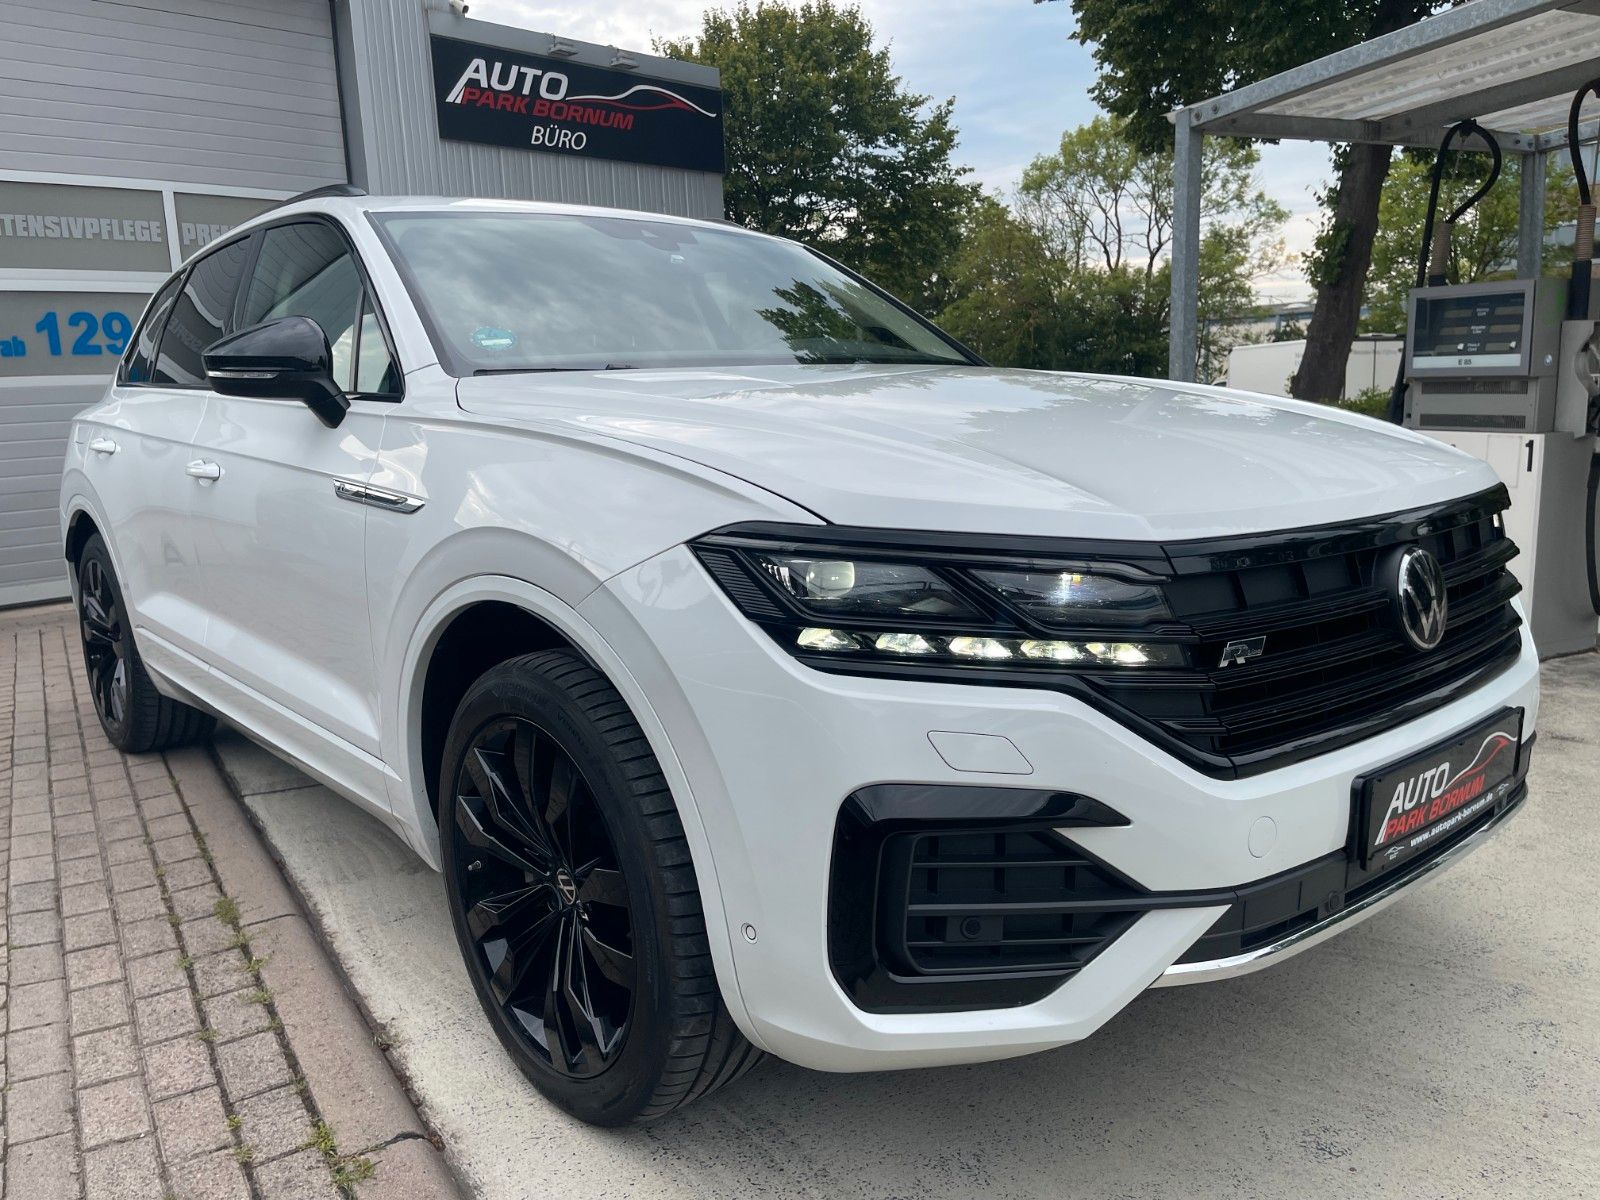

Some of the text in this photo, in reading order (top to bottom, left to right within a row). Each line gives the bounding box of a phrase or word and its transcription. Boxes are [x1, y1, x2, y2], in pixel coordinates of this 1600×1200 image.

[446, 58, 569, 103] AUTO
[461, 87, 634, 131] PARK BORNUM
[530, 125, 587, 150] BÜRO
[0, 213, 162, 242] TENSIVPFLEGE
[0, 335, 26, 358] ab
[35, 311, 132, 356] 129
[1525, 440, 1534, 472] 1
[1374, 762, 1450, 845] AUTO
[1384, 775, 1485, 843] PARK BORNUM
